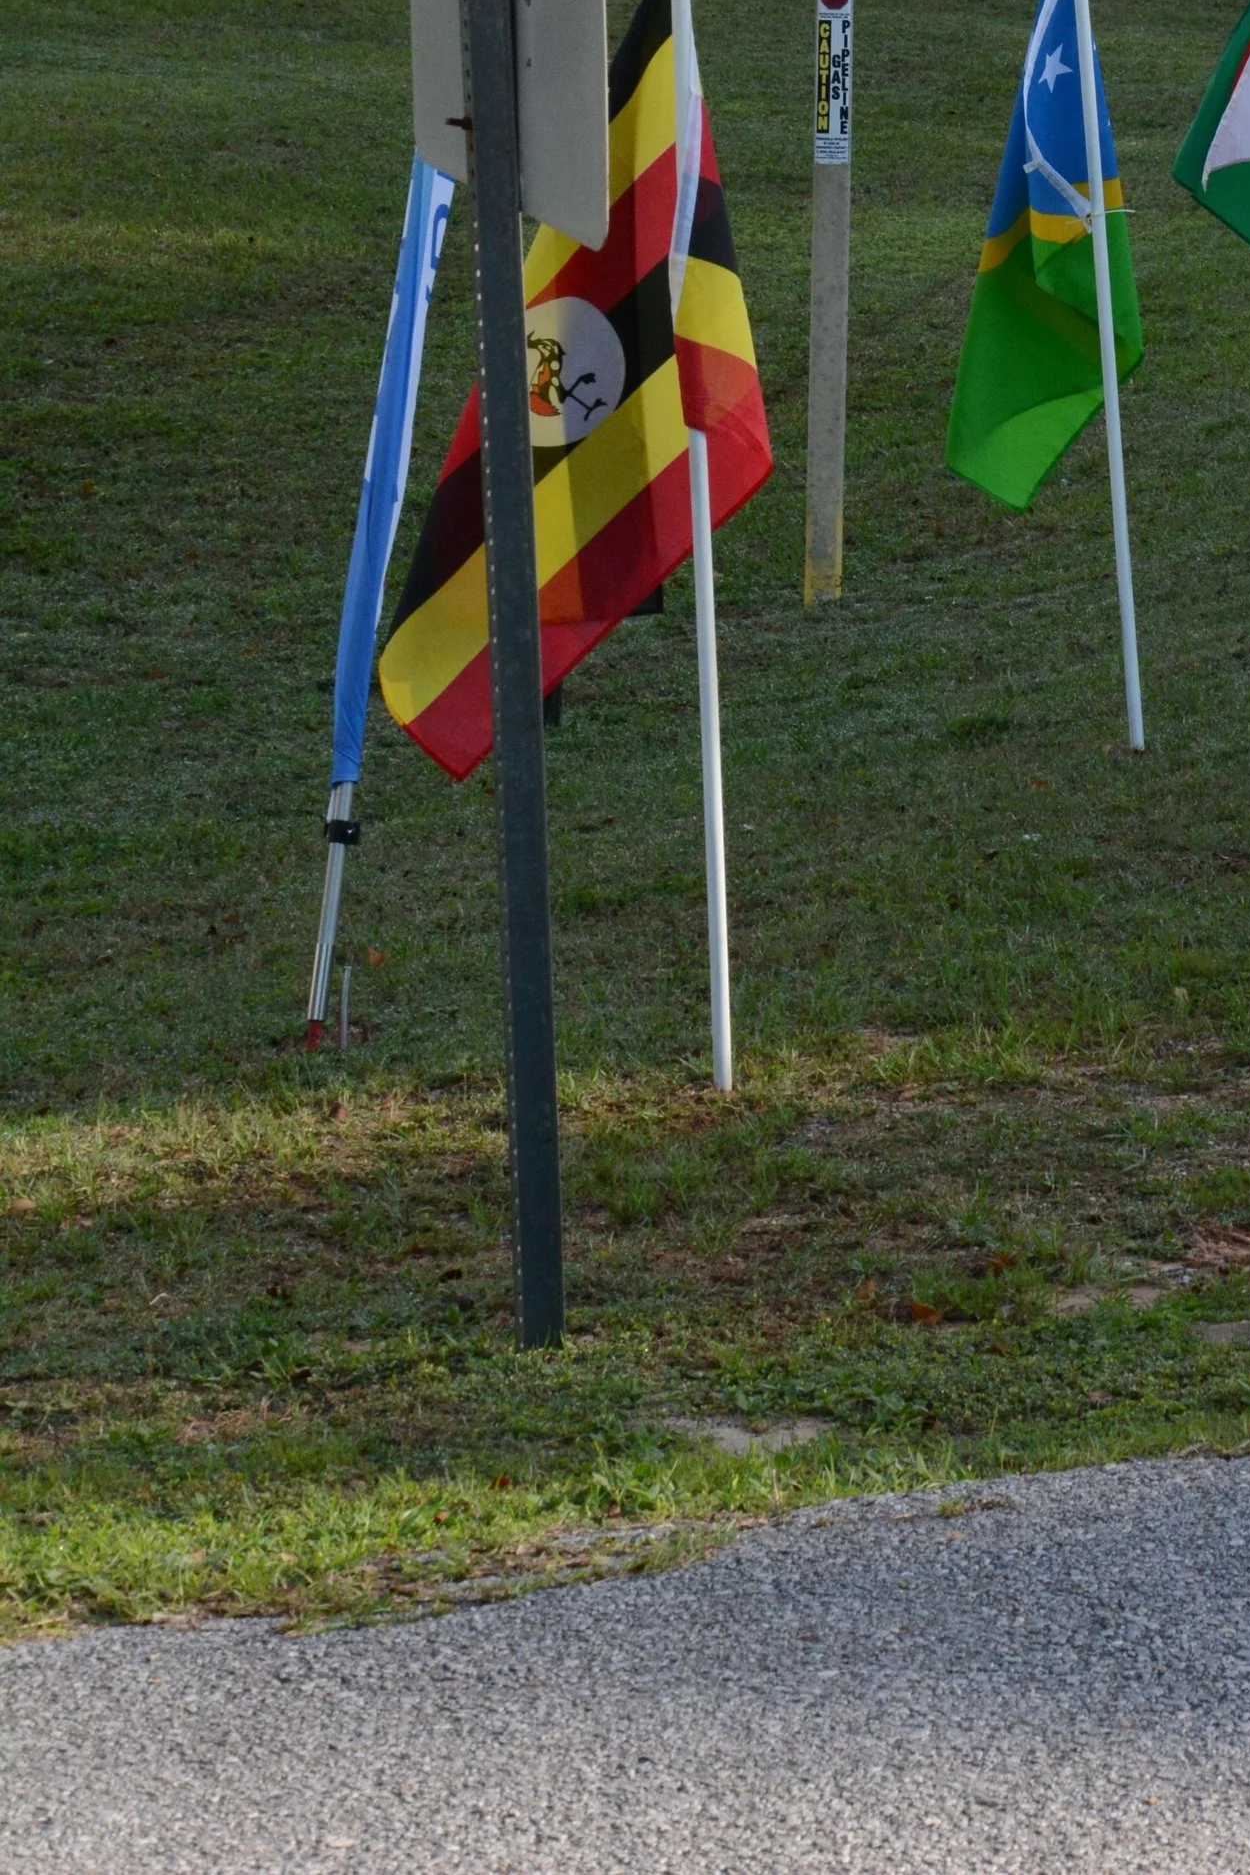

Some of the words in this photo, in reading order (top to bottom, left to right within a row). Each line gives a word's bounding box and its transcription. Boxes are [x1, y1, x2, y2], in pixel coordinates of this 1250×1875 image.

[817, 22, 830, 131] CAUTION
[831, 54, 841, 100] GAS
[839, 20, 850, 135] PIPELINE
